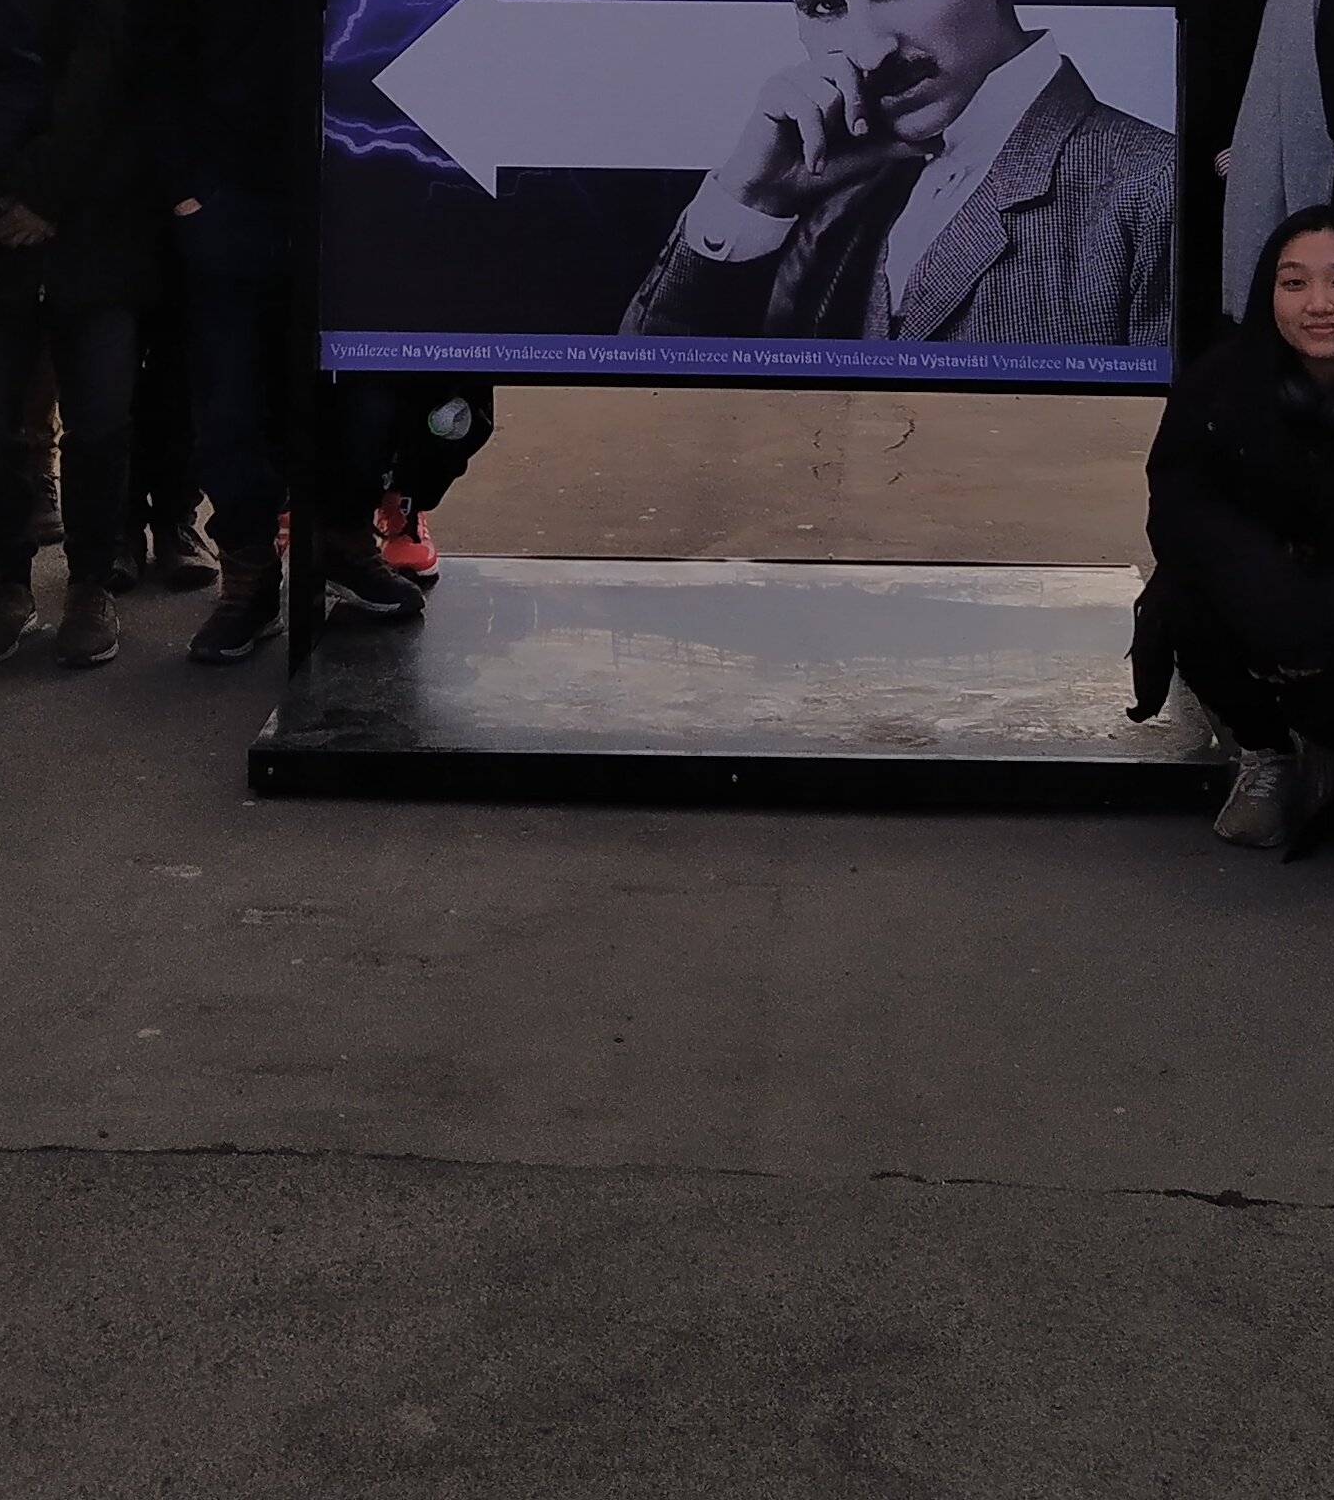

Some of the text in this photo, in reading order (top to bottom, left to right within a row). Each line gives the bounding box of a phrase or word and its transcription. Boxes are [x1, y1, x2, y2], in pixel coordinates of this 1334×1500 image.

[330, 343, 1157, 373] Vynálezce Na Výstavišti Vynálezce Na Výstavišti Vynálezce Na Výstavišti Vynálezce Na Výstavišti Vynálezce Na Výstavišti
